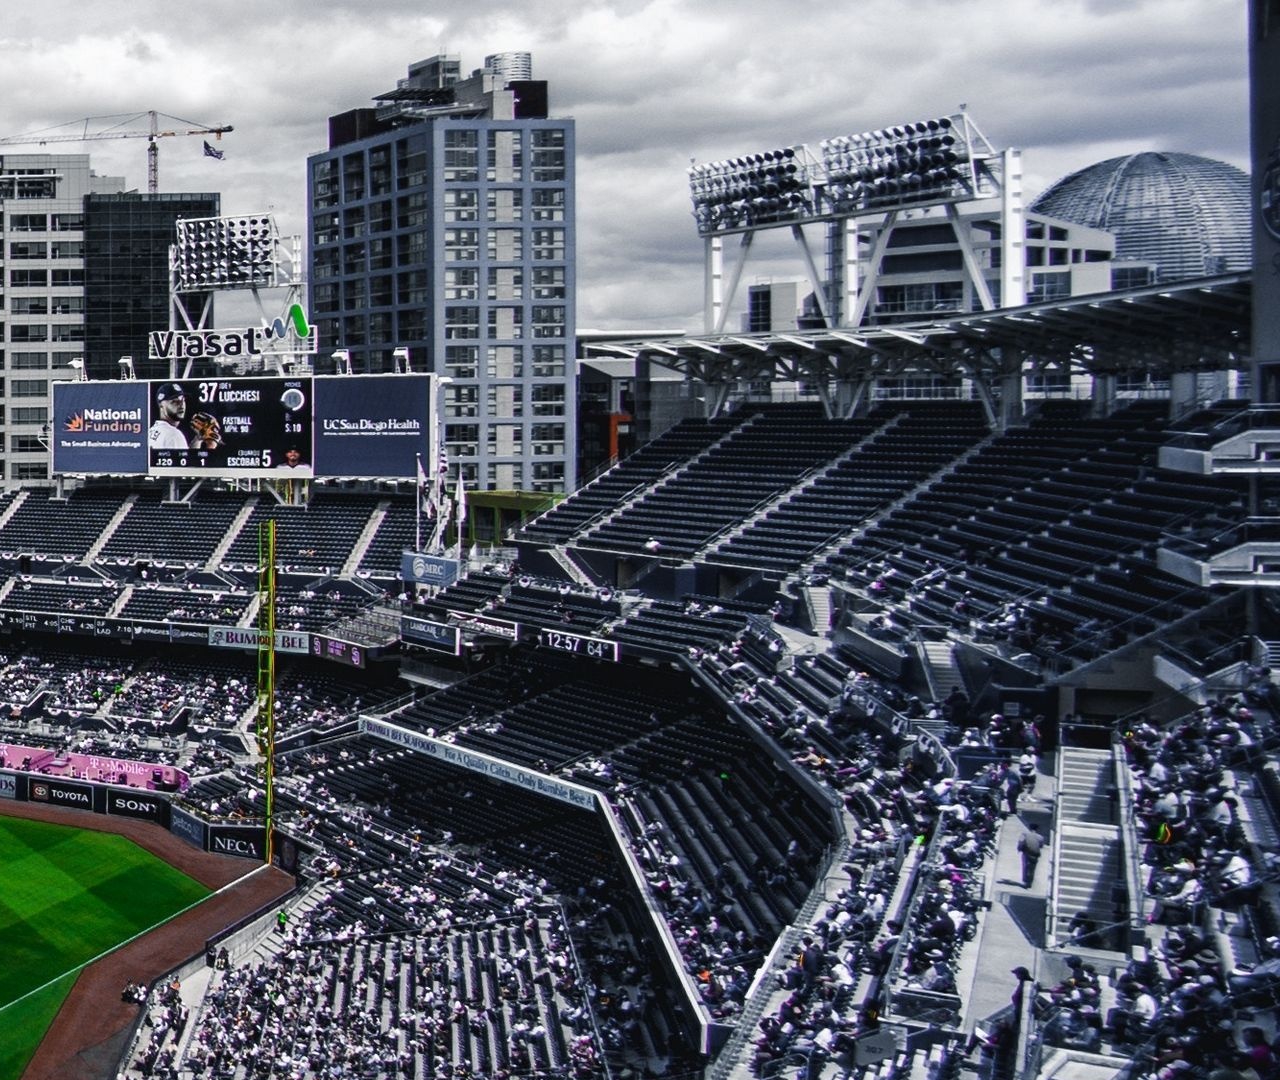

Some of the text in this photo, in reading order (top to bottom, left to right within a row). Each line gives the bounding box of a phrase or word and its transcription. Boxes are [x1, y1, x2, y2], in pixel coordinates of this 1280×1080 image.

[152, 327, 261, 358] Viasat
[198, 382, 218, 403] 37
[219, 391, 260, 402] LUCCHESI
[85, 408, 141, 420] National
[85, 421, 141, 434] Funding
[323, 419, 420, 431] UC San Diego Health
[227, 450, 272, 467] ESCOBAR 5
[424, 564, 444, 576] MRC
[96, 627, 111, 635] LAD
[547, 632, 581, 651] 12:57
[463, 754, 488, 771] Quality
[538, 779, 568, 799] Bumble
[569, 789, 585, 803] Bee
[51, 788, 89, 803] TOYOTA
[214, 836, 258, 856] NECA
